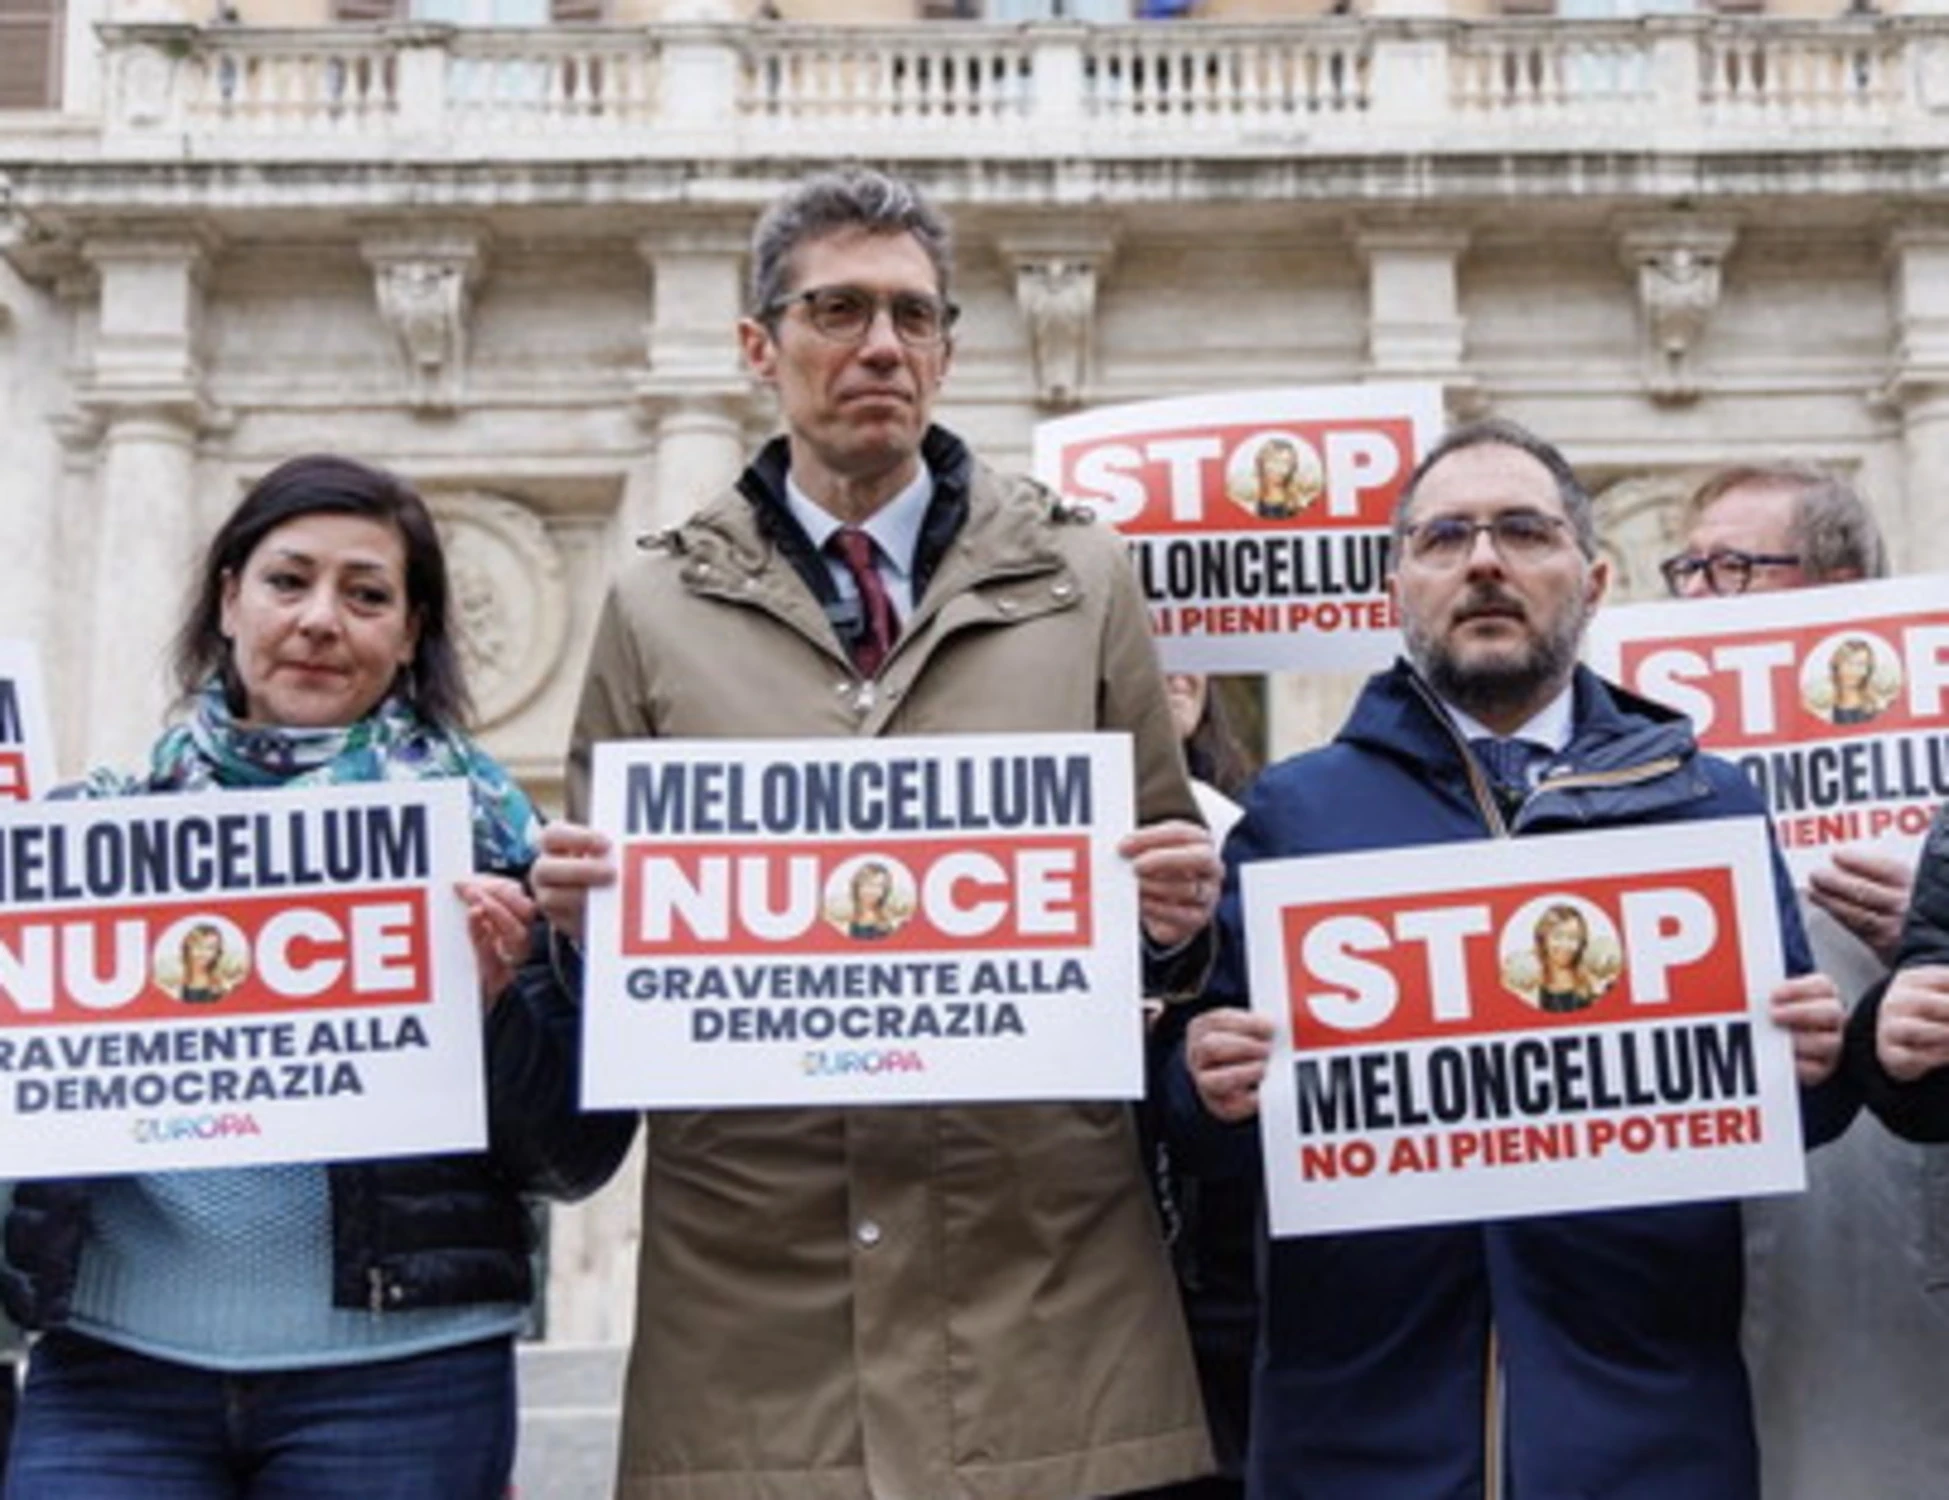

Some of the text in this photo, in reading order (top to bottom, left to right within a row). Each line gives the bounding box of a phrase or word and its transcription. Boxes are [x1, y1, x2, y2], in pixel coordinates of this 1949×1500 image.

[1073, 430, 1400, 523] STOP
[1128, 535, 1391, 601] LONCELLU
[1181, 604, 1279, 635] PIENI
[626, 755, 1092, 834] MELONCELLUM
[1780, 811, 1860, 848] IENI
[0, 804, 429, 903] ELONCELLUM
[639, 848, 1078, 942] NUOCE
[626, 960, 1088, 1000] GRAVEMENTE ALLA
[1302, 887, 1719, 1031] STOP
[0, 1016, 429, 1071] RAVEMENTE ALLA
[691, 1004, 1025, 1041] DEMOCRAZIA
[15, 1062, 363, 1113] DEMOCRAZIA
[1294, 1021, 1758, 1135] MELONCELLUM
[1301, 1107, 1761, 1181] NO AI PIENI POTERI
